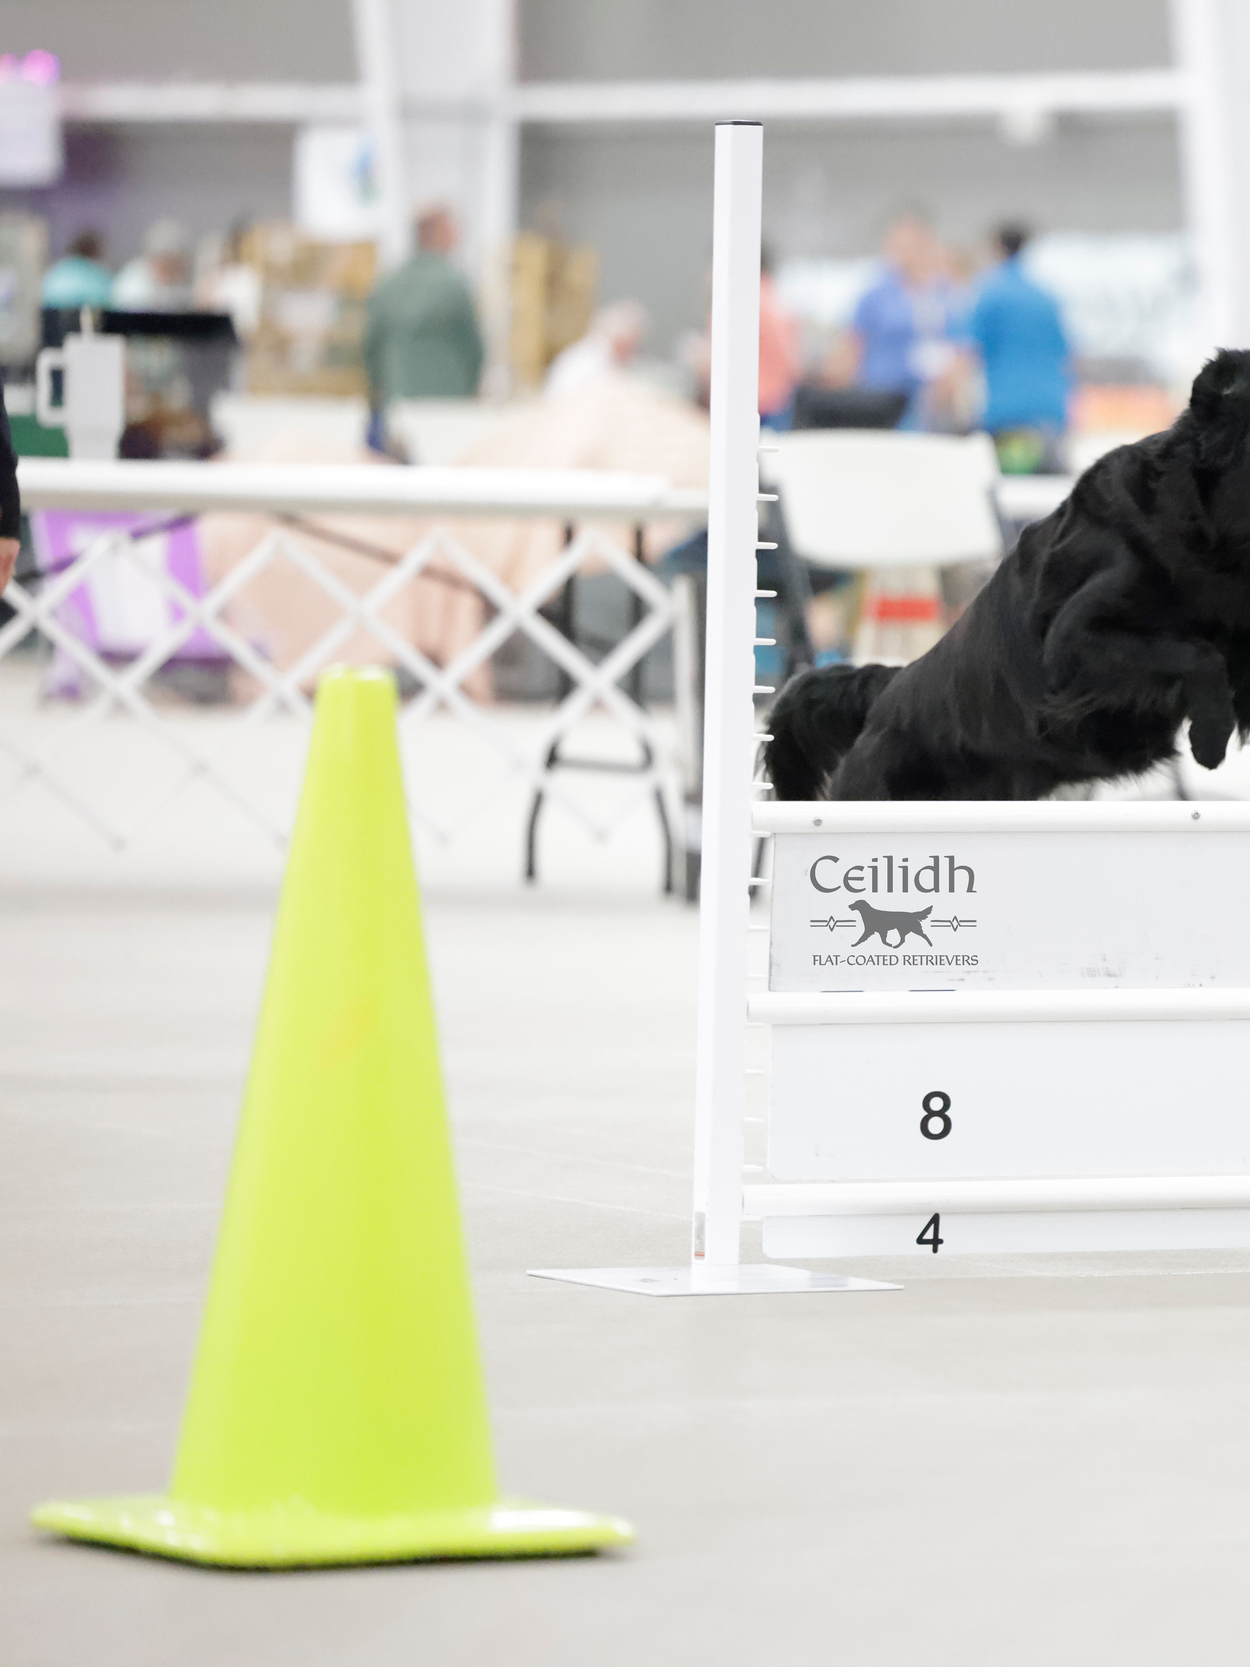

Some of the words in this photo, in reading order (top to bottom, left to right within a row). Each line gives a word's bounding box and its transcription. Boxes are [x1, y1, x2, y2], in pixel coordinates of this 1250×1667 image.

[809, 854, 978, 894] Ceilidh
[811, 953, 899, 967] FLAT-COATED
[901, 953, 979, 967] RETRIEVERS
[919, 1090, 953, 1141] 8
[915, 1212, 944, 1254] 4
